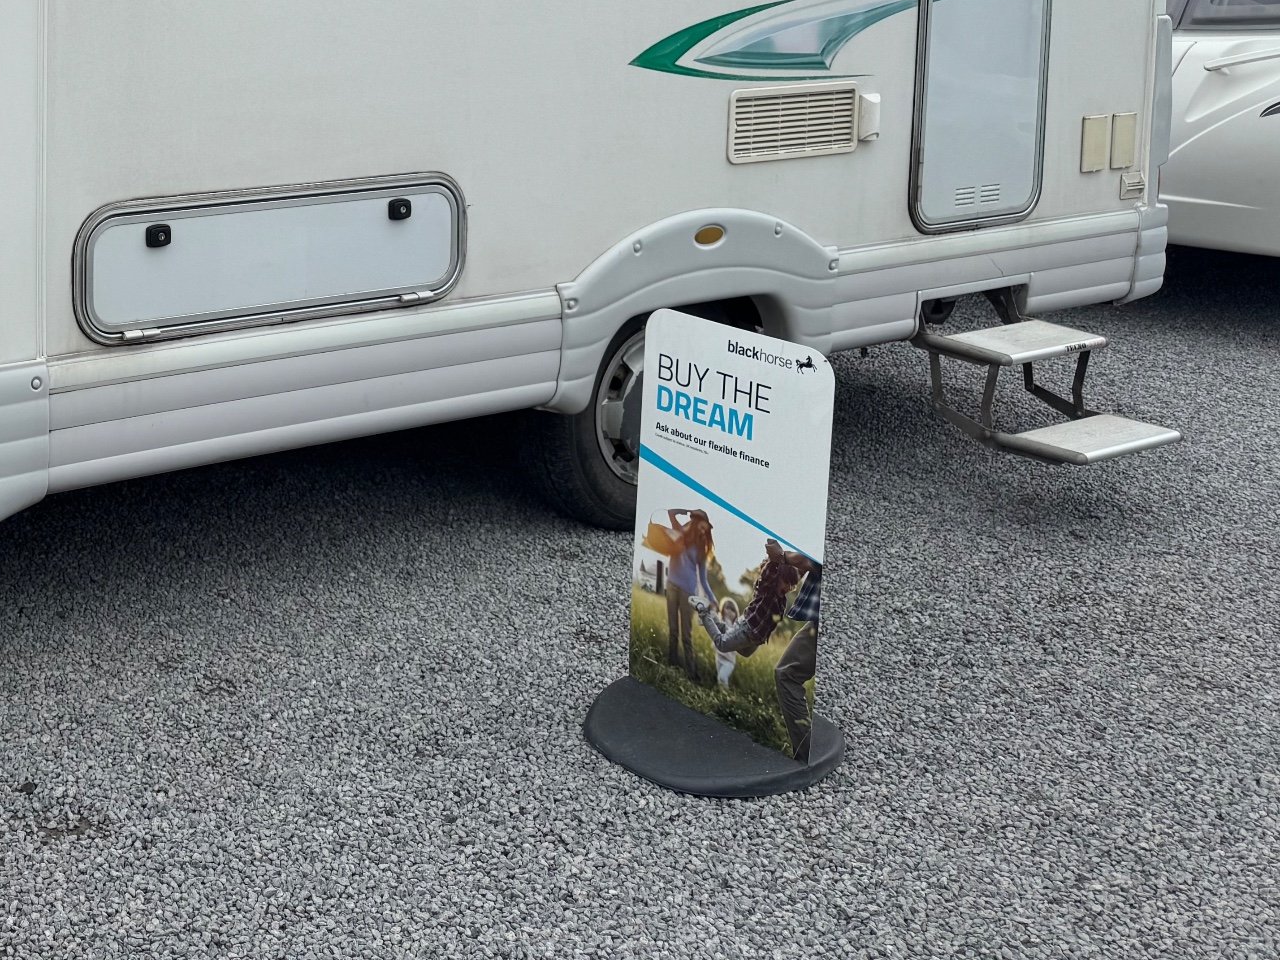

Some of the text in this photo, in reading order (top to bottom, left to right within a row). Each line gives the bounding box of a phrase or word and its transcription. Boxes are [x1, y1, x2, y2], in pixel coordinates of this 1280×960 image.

[727, 339, 793, 370] blackhorse
[657, 353, 772, 414] BUY THE
[656, 384, 754, 441] DREAM
[655, 421, 670, 434] Ask
[670, 427, 693, 442] about
[693, 436, 707, 447] our
[708, 440, 738, 458] flexible
[739, 450, 770, 469] finance
